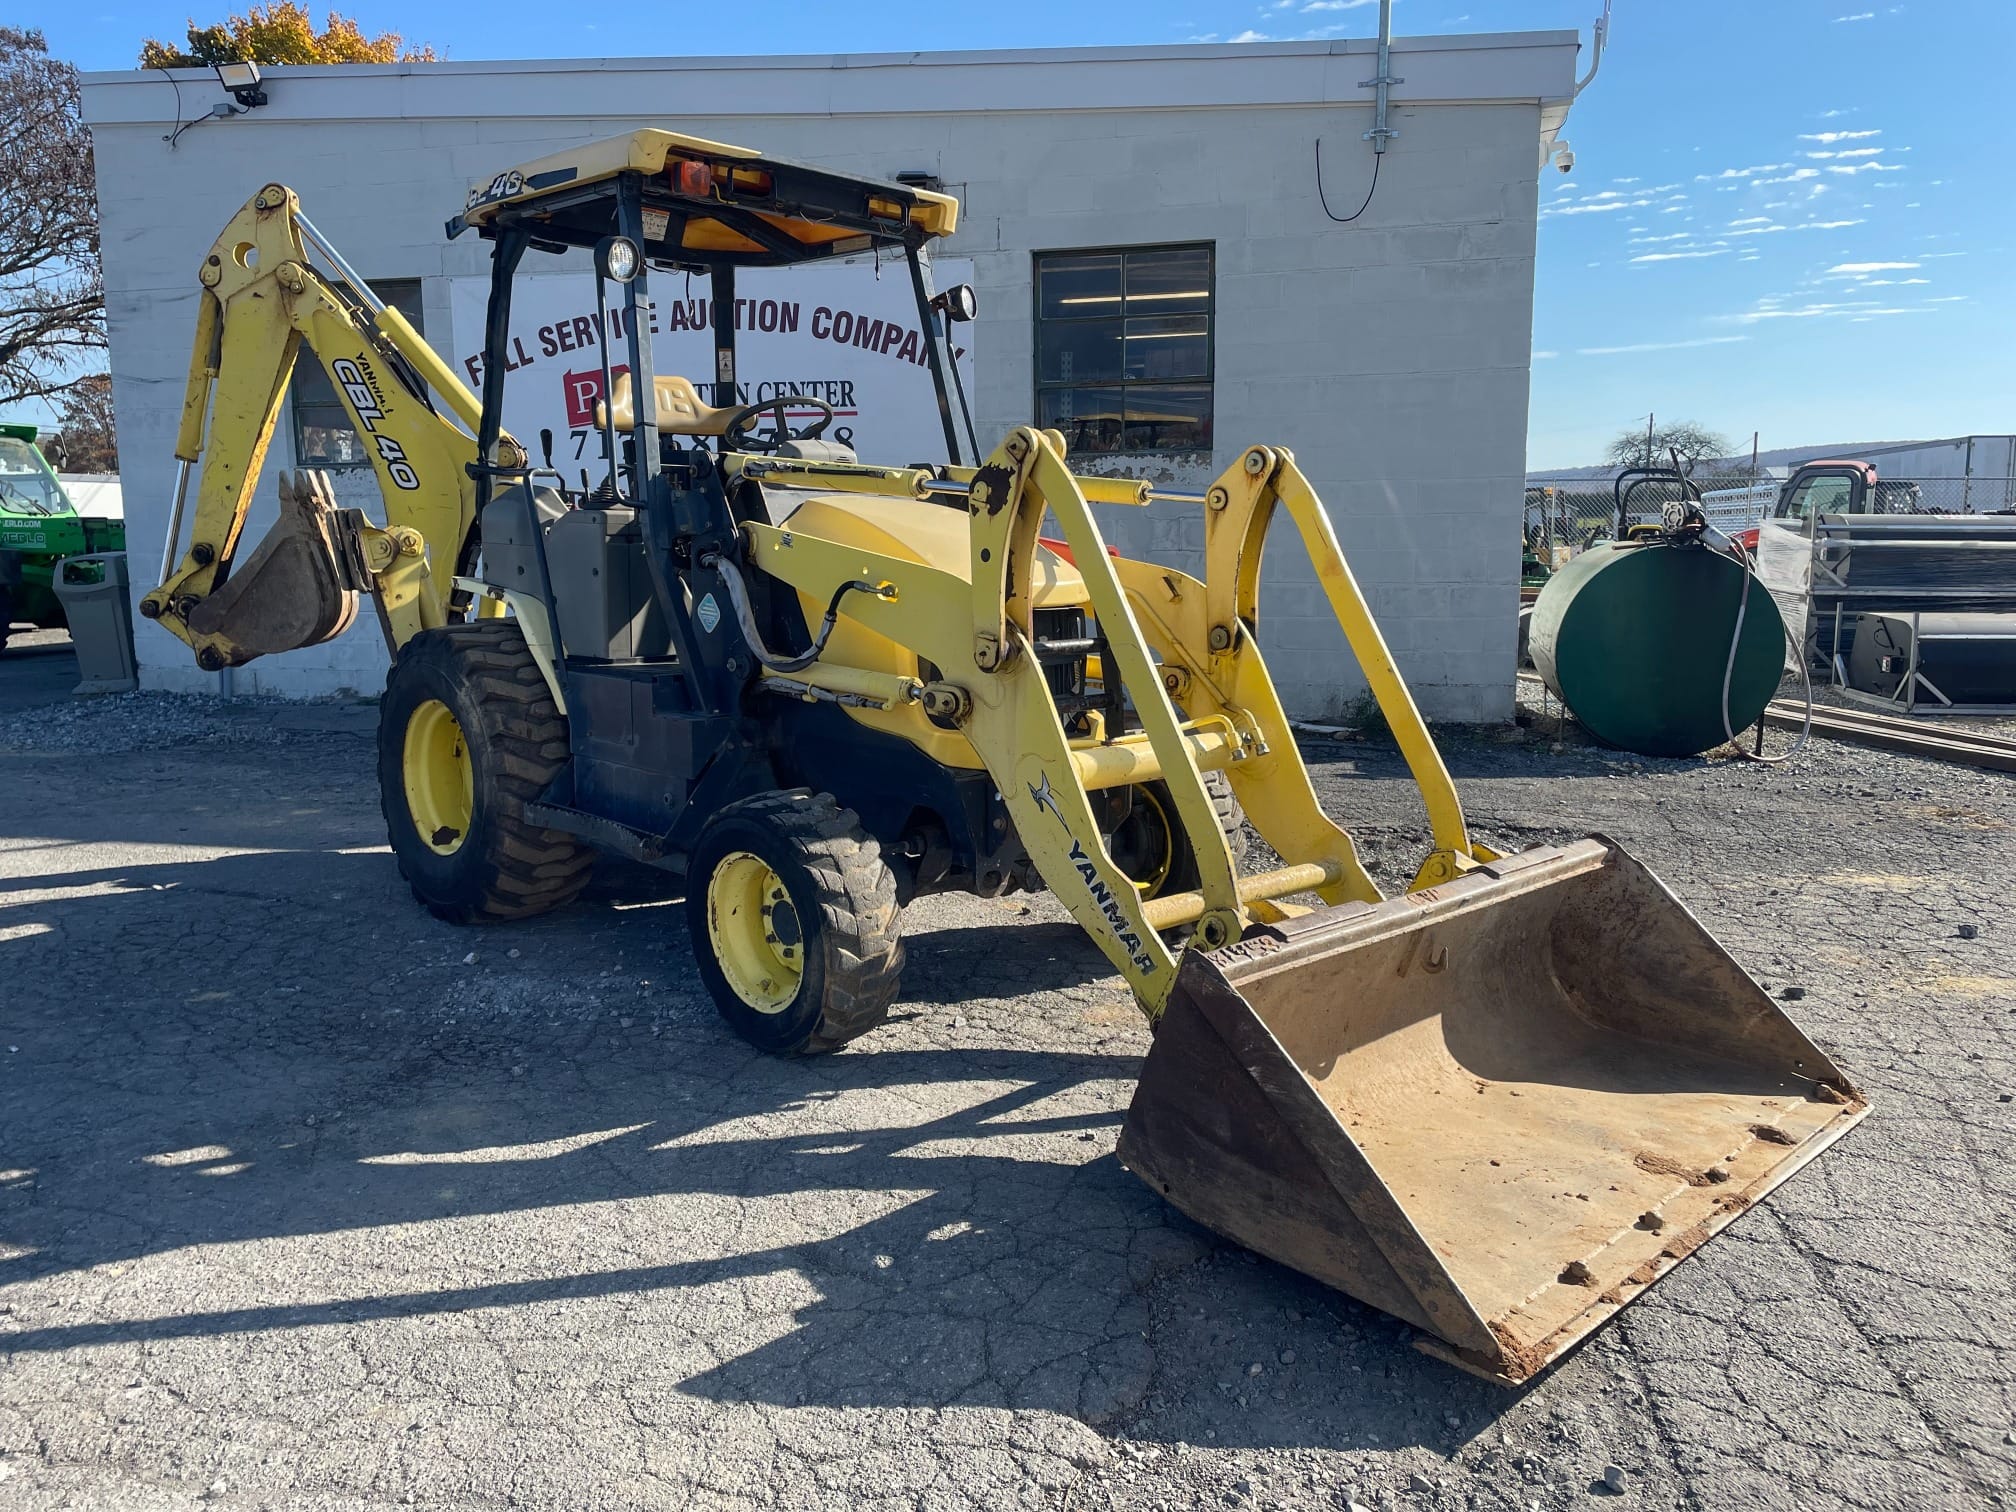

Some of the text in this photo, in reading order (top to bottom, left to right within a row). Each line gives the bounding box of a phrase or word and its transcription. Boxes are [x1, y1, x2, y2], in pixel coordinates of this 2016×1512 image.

[465, 337, 534, 386] FLL
[670, 298, 799, 333] AUTION
[757, 380, 856, 408] CENTER
[332, 358, 420, 490] CBL 40
[1068, 838, 1158, 976] YANMAR
